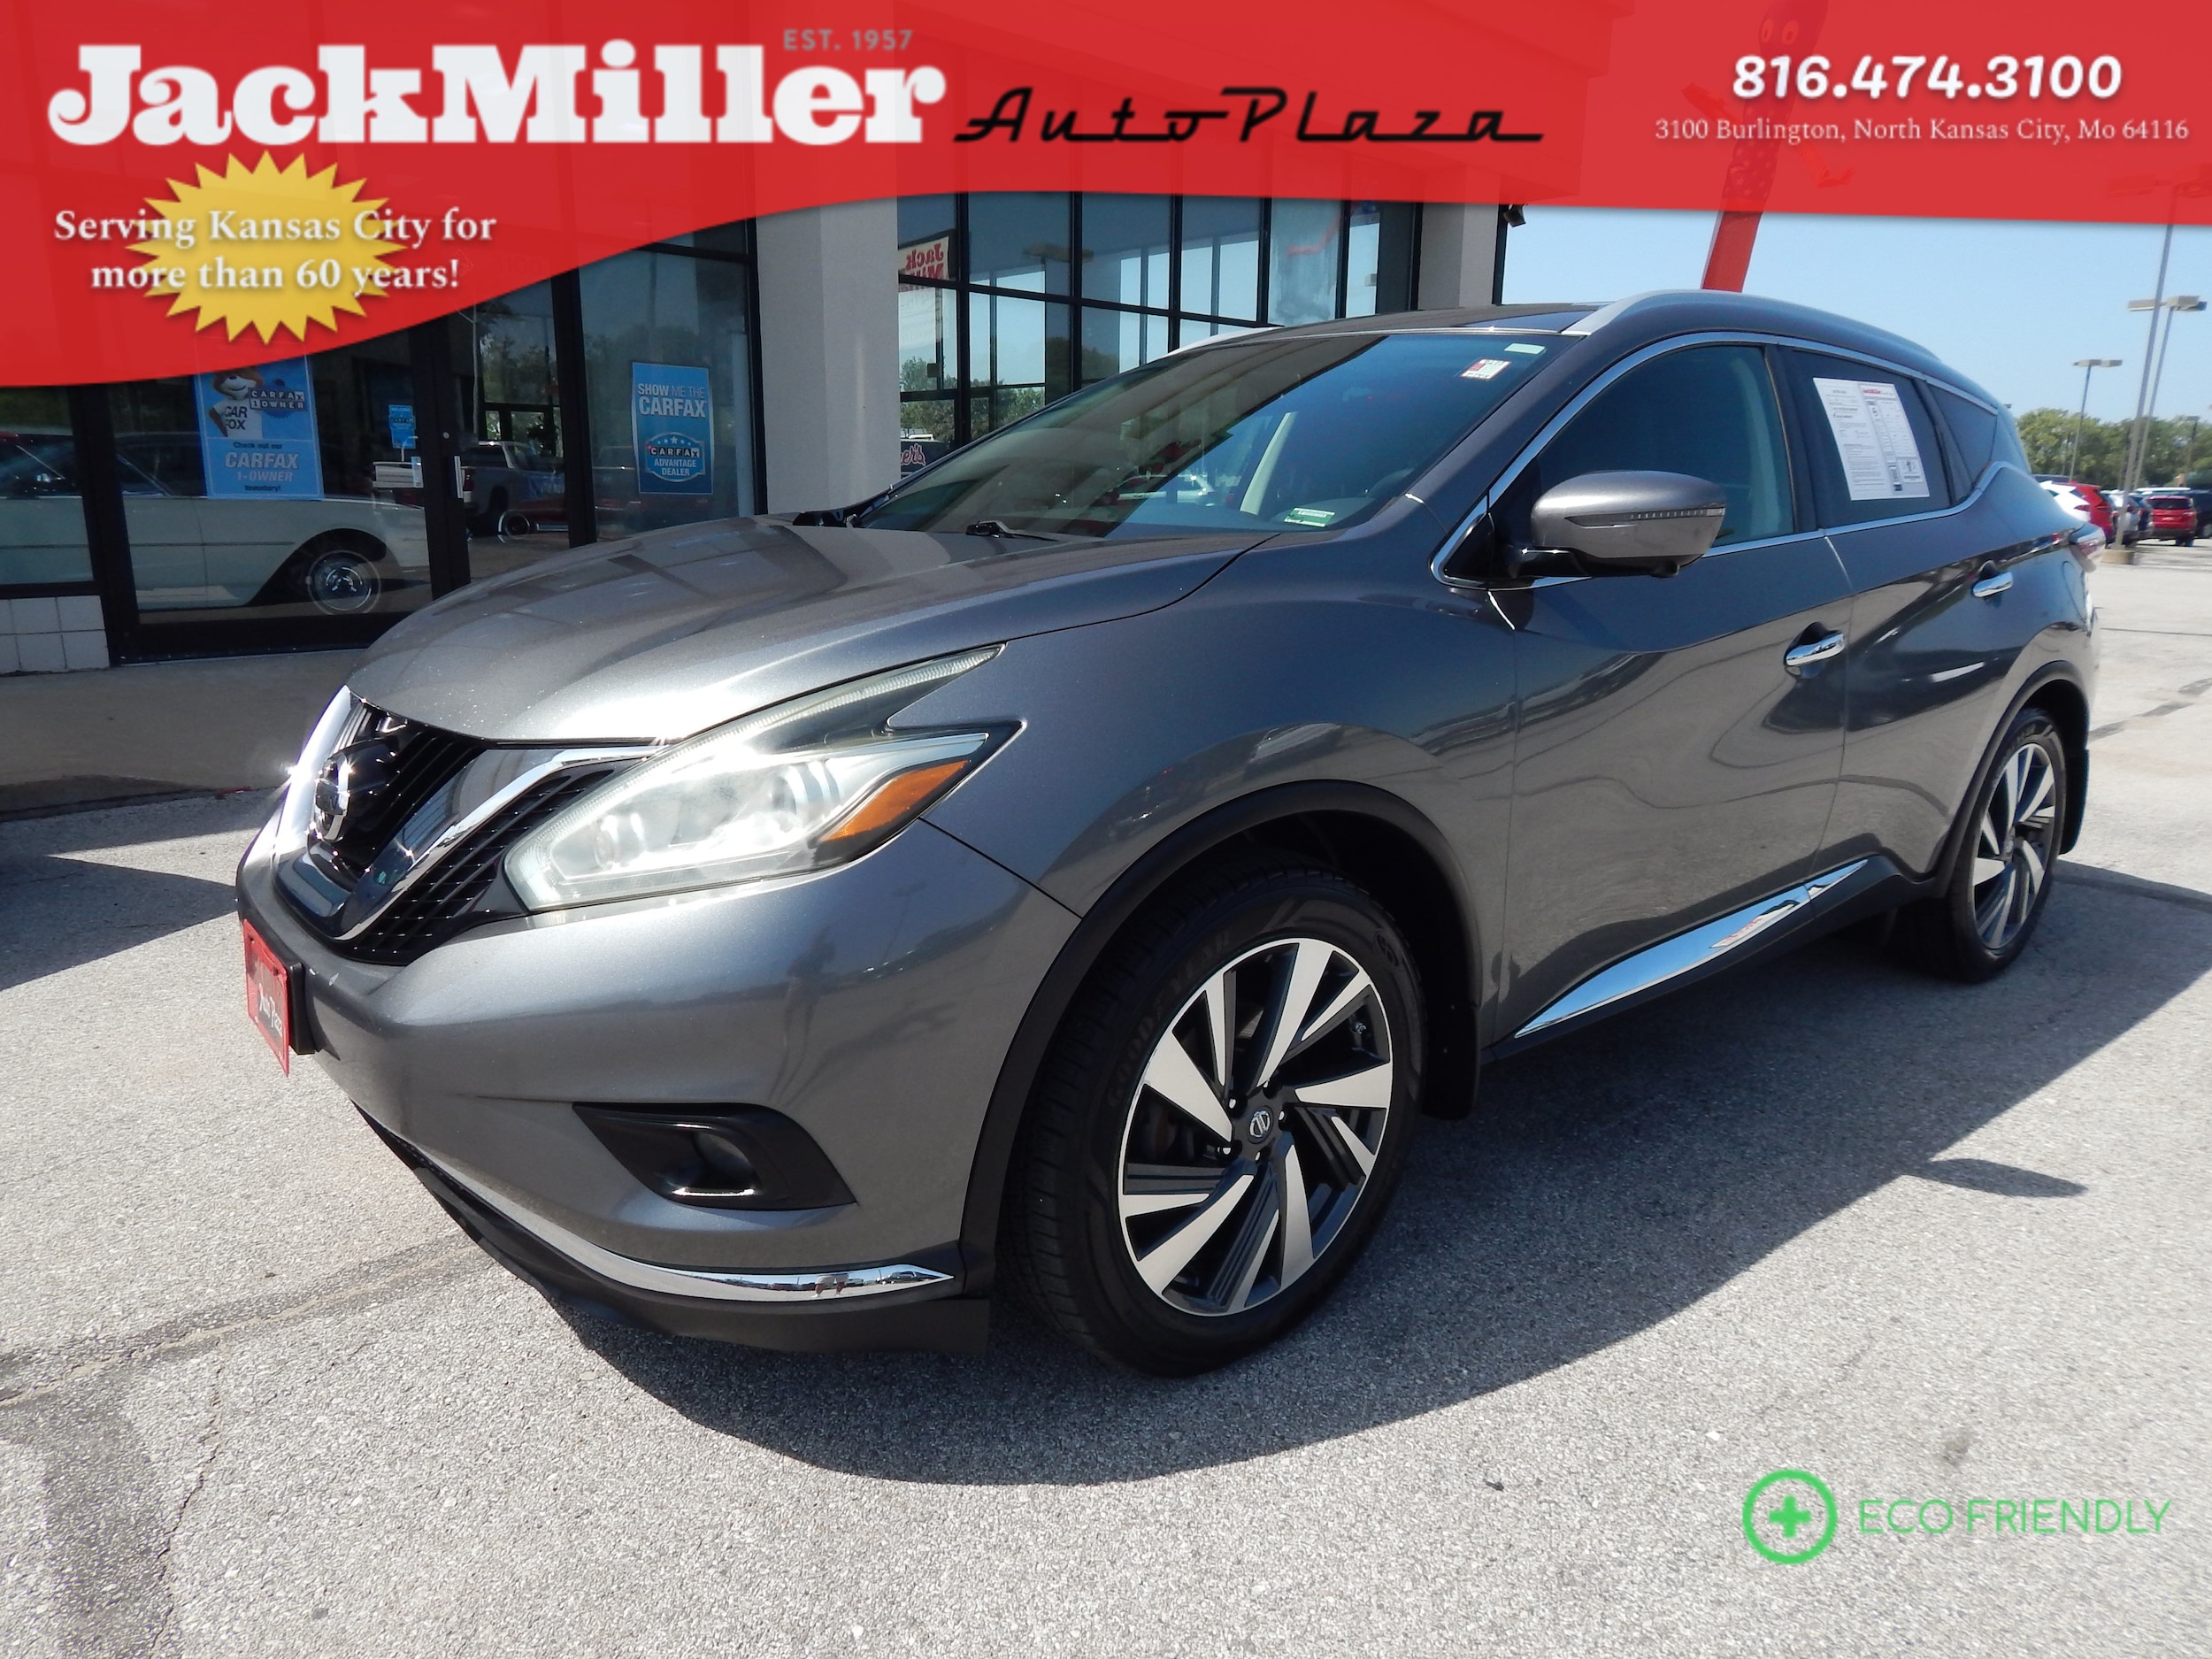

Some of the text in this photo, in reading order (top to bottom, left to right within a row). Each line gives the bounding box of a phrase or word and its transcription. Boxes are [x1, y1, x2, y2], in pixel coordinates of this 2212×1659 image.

[251, 390, 305, 401] CARFAX
[638, 382, 705, 398] SHOW ME THE
[224, 406, 248, 419] CAR
[639, 396, 707, 419] CARFAX
[650, 447, 700, 457] CARFAX
[225, 451, 299, 469] CARFAX
[654, 458, 697, 468] ADVANTAGE
[237, 472, 294, 482] 1-OWNER
[662, 467, 690, 476] DEALER
